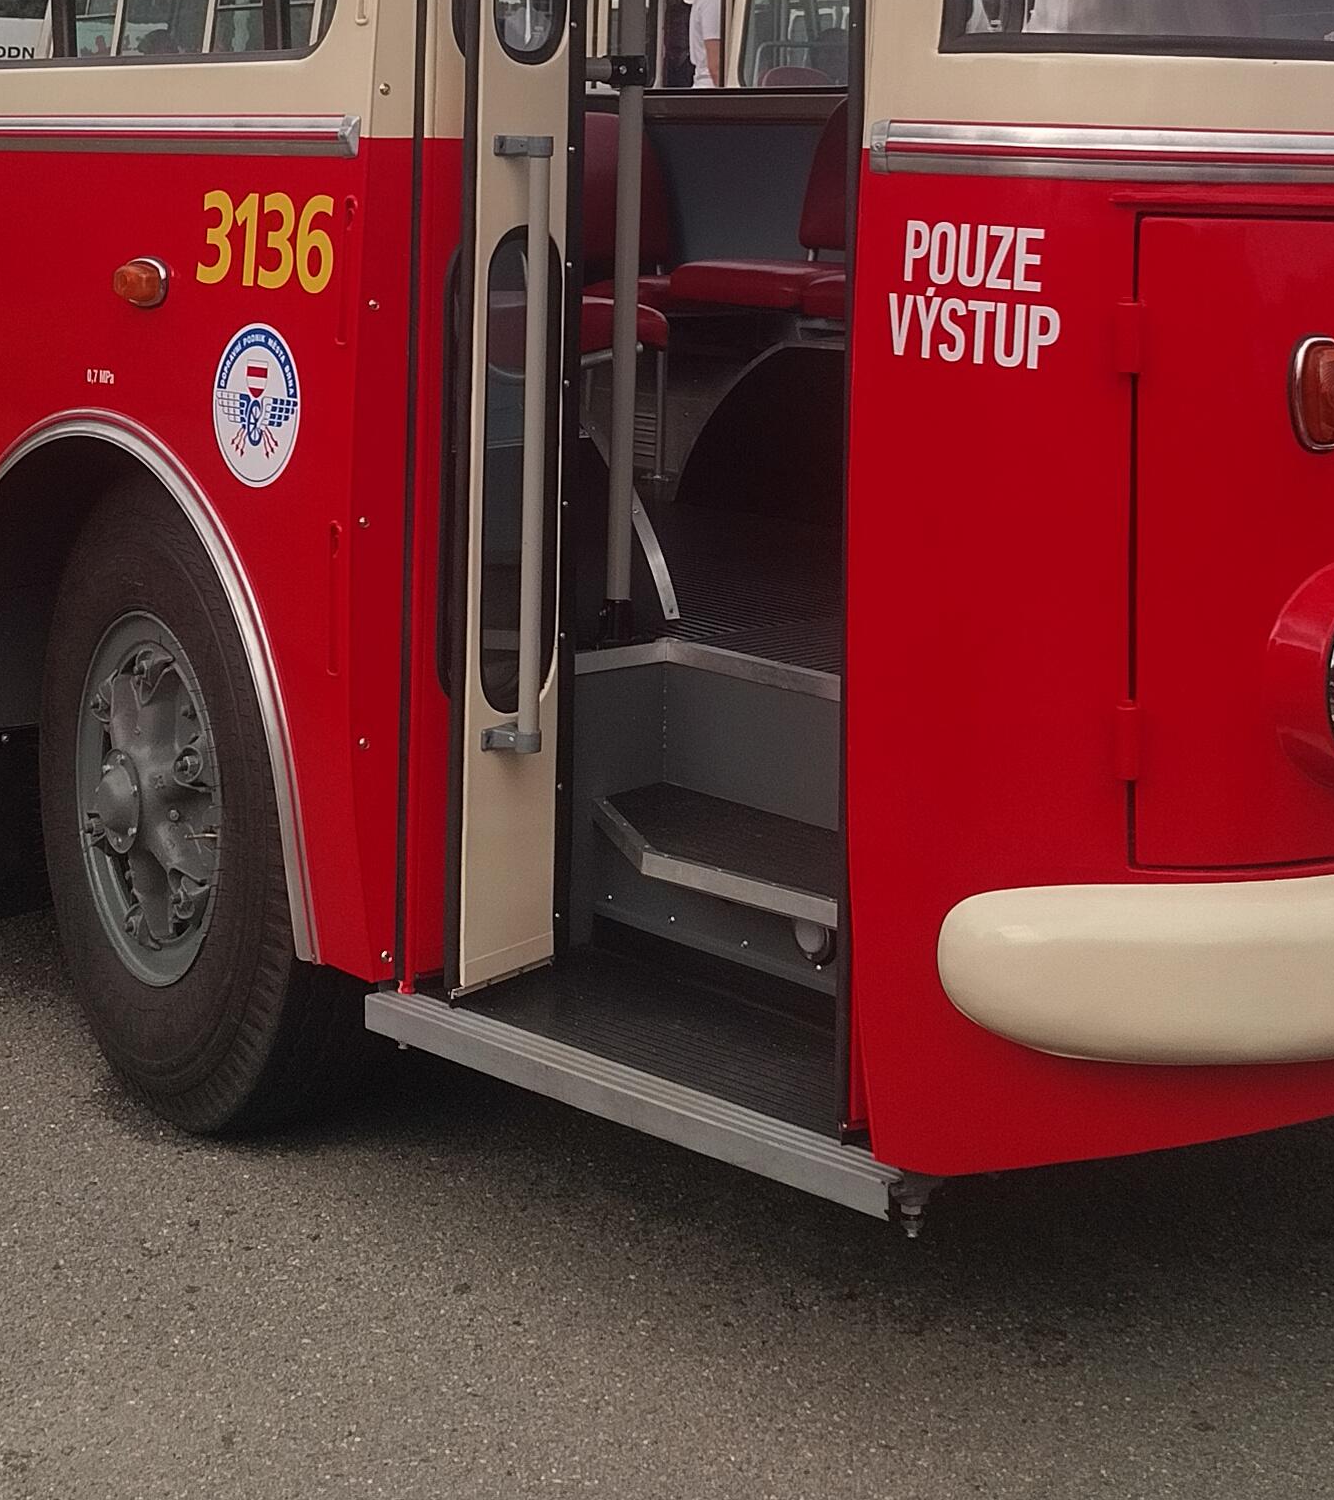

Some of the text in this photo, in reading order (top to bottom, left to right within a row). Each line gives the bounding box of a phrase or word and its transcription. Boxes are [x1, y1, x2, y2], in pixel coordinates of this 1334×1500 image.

[195, 189, 335, 294] 3136
[903, 219, 1045, 293] POUZE
[220, 333, 295, 396] DOPRAVNÍ PODNIK MĚSTA BRNA
[889, 287, 1060, 370] VÝSTUP
[87, 368, 115, 385] 0,7 MPa
